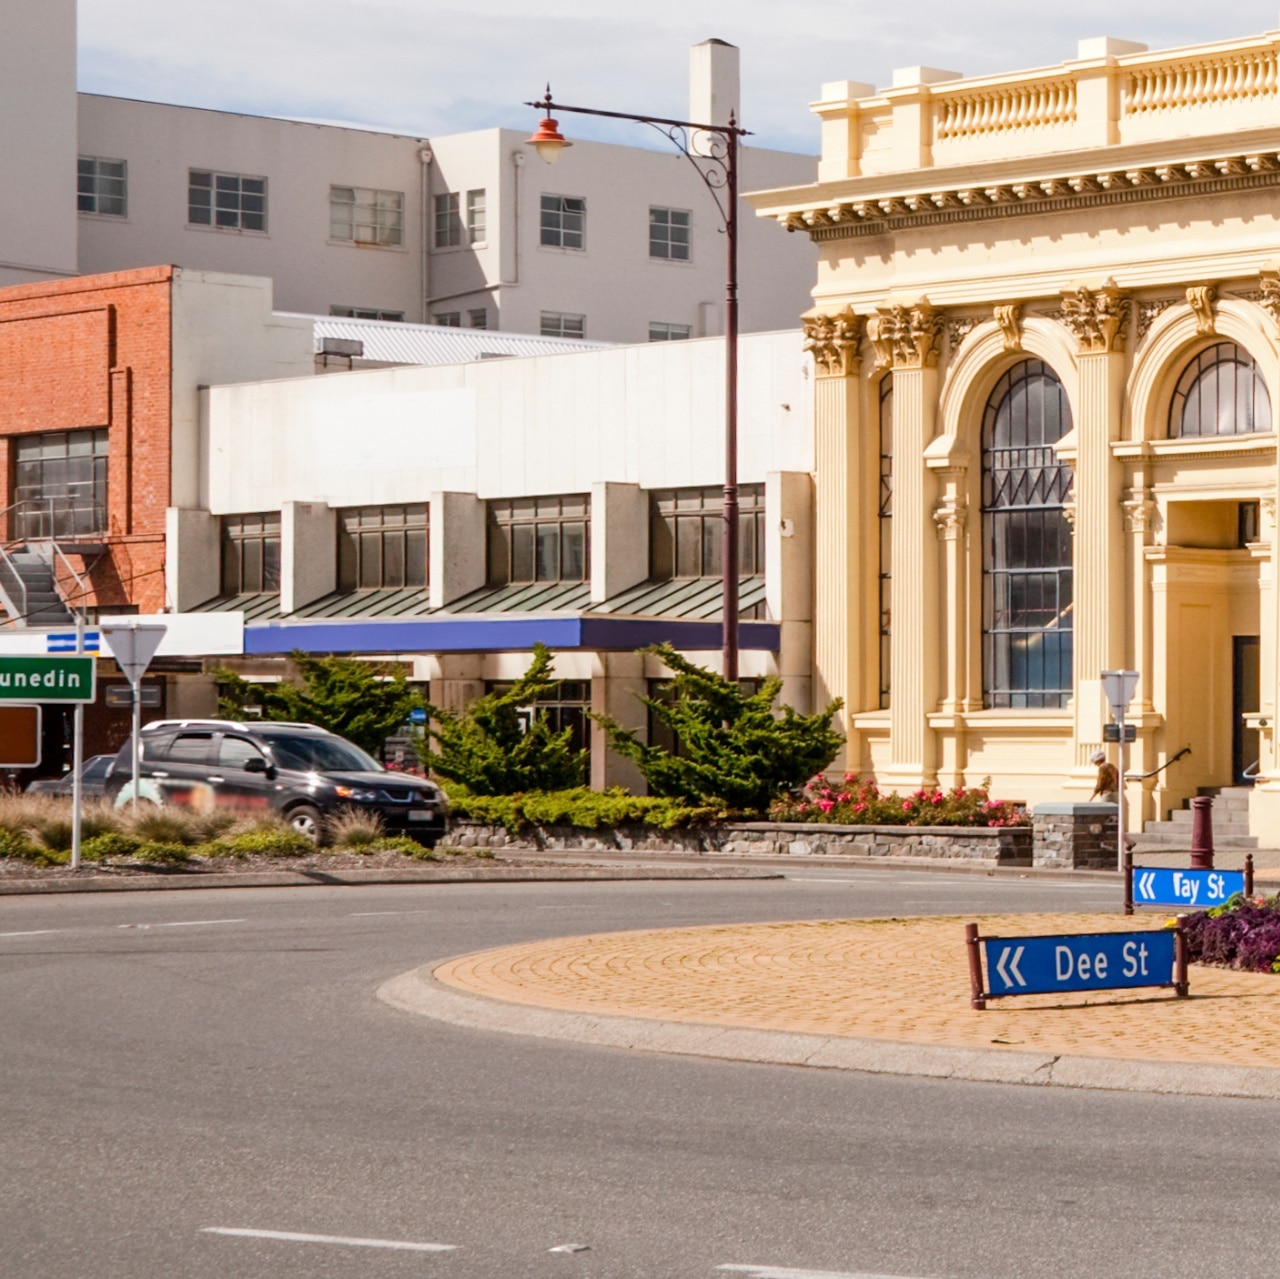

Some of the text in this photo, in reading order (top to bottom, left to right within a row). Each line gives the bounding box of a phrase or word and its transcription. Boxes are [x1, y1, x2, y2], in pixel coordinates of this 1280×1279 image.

[1207, 873, 1225, 899] St
[1055, 941, 1148, 981] Dee St
